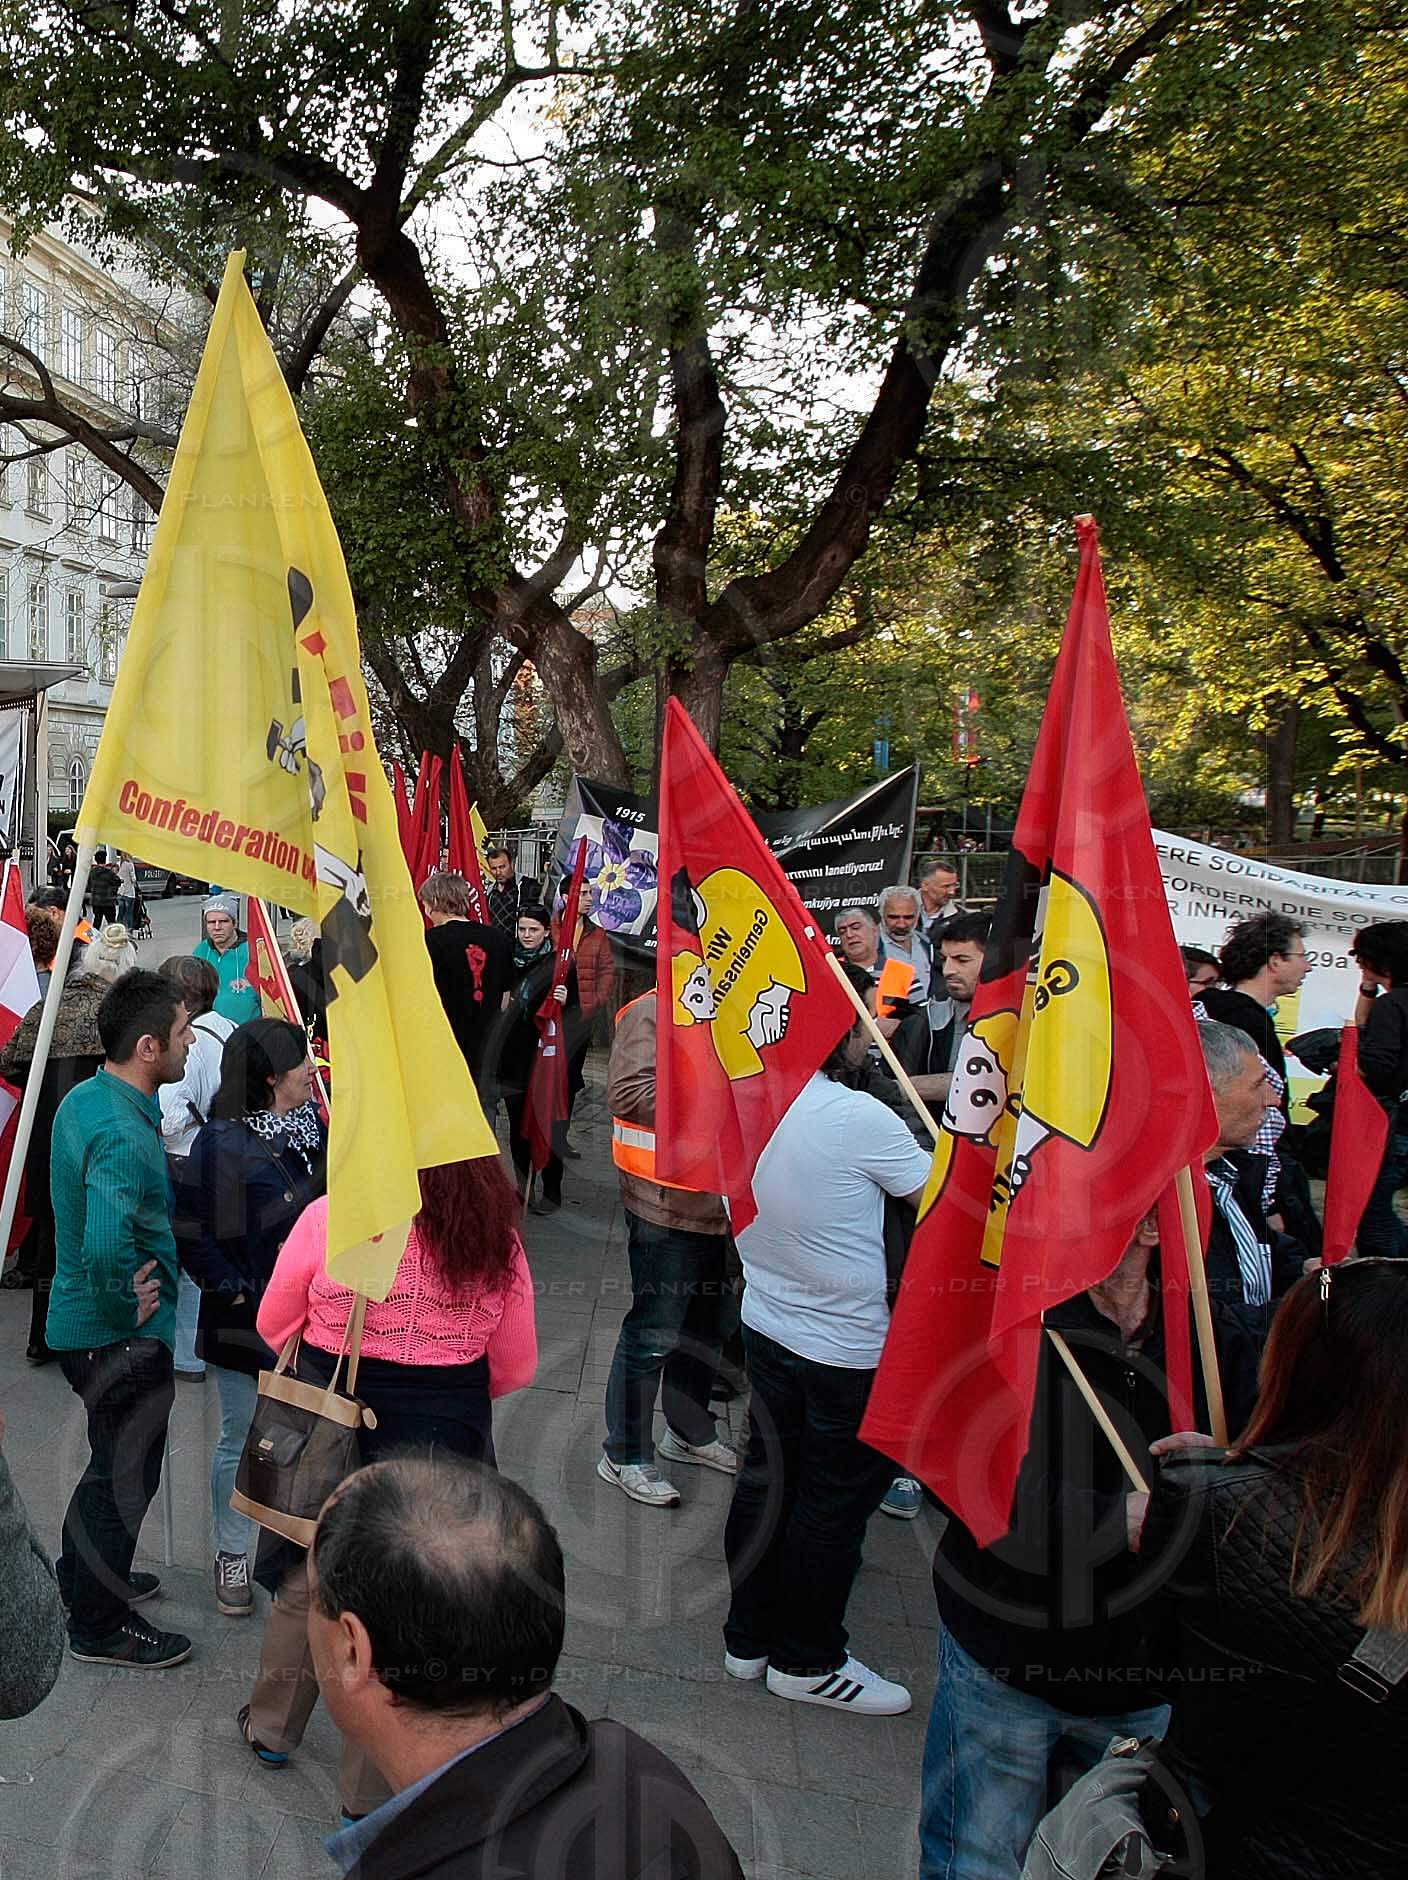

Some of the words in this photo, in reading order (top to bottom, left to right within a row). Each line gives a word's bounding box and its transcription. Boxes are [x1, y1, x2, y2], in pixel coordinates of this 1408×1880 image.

[615, 806, 646, 823] 1915
[118, 779, 300, 876] Confederation
[1155, 844, 1202, 867] ERE
[1279, 902, 1324, 919] DIE
